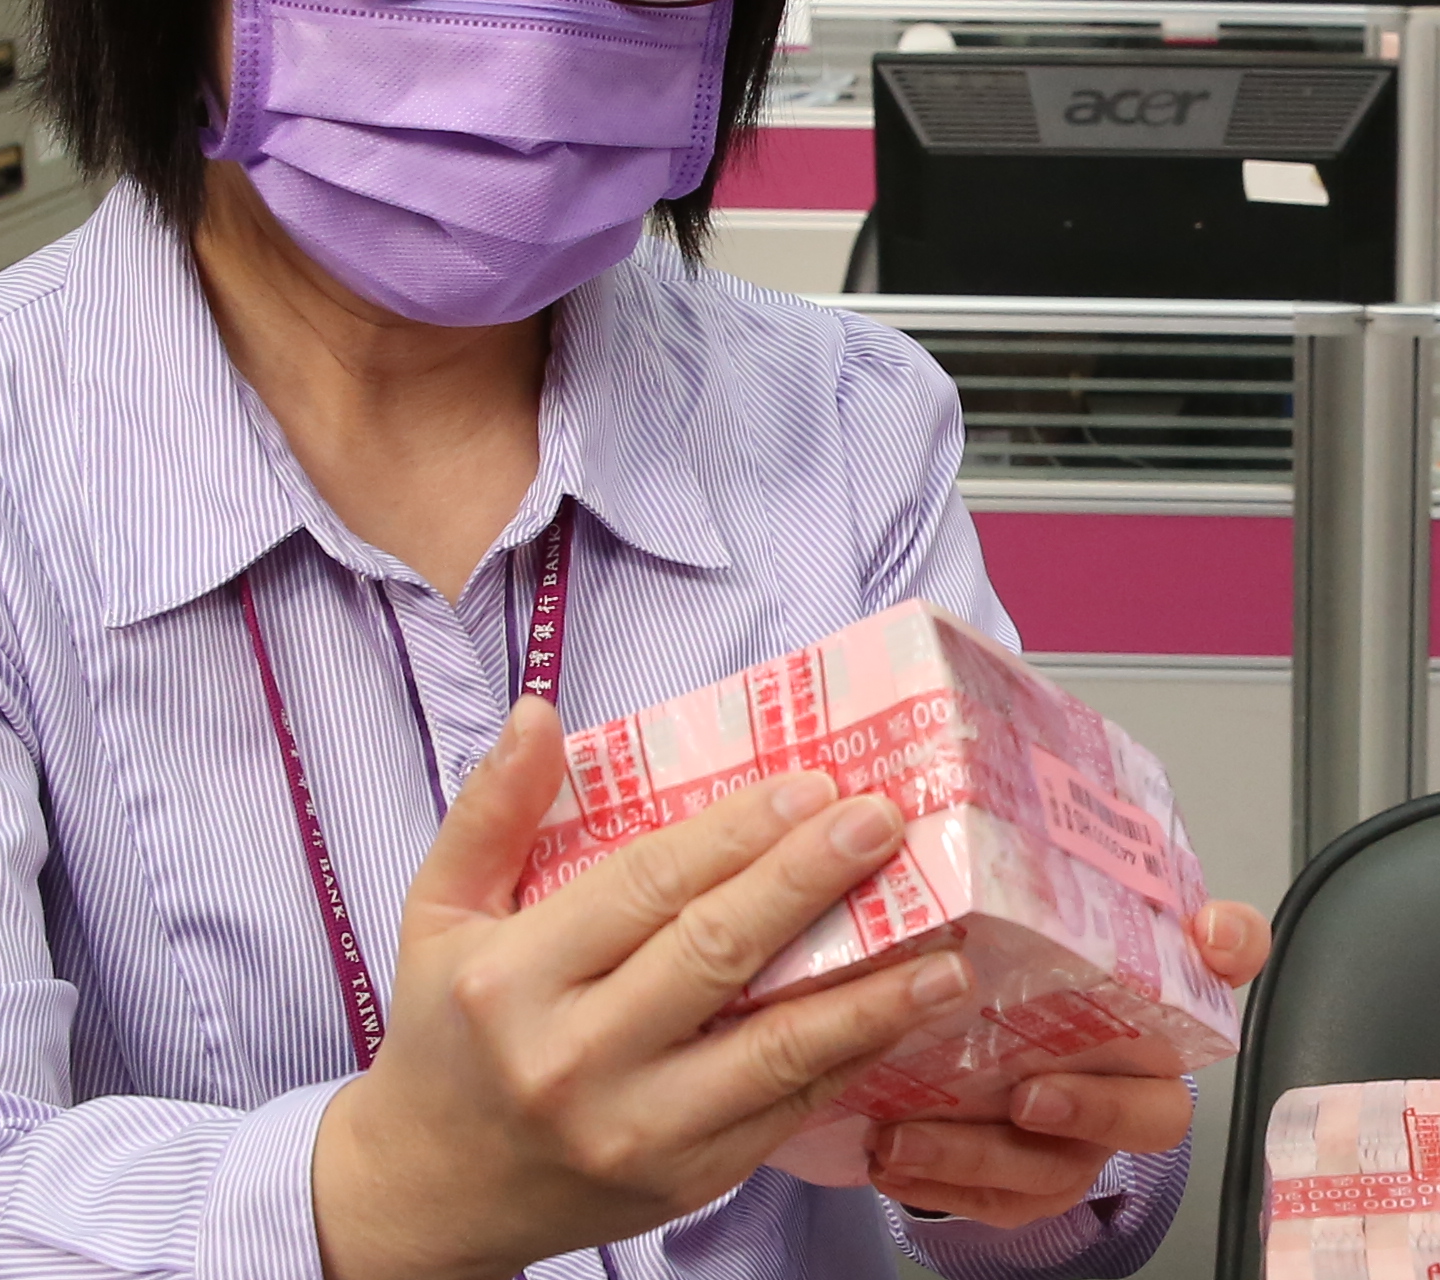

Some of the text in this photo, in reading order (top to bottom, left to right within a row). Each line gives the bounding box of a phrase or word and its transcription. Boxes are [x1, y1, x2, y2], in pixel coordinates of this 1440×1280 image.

[1065, 87, 1211, 126] acer
[525, 523, 561, 694] 臺灣銀行 BANK
[319, 856, 385, 1059] BANK OF TAIWA
